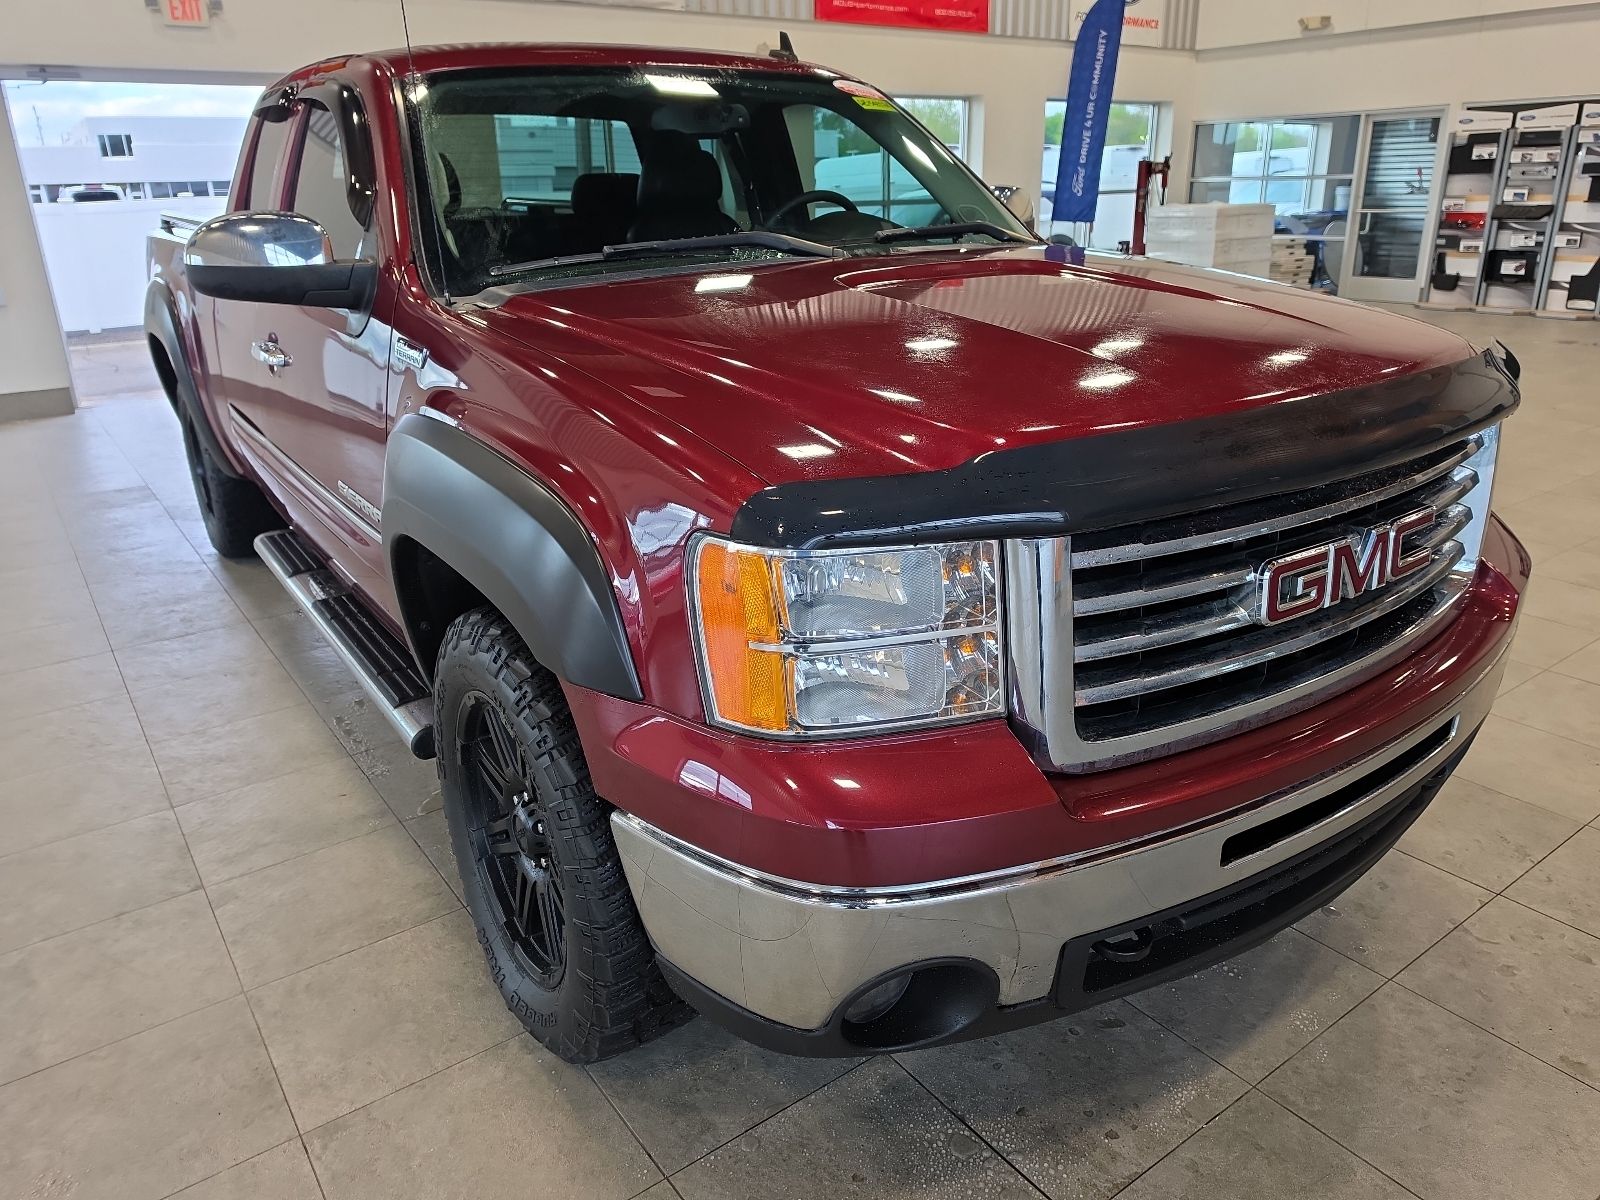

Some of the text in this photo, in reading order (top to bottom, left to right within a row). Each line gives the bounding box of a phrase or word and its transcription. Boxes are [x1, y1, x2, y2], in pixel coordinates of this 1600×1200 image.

[1079, 129, 1092, 164] DRIVE
[1086, 102, 1095, 119] UR
[1258, 504, 1437, 628] GMC
